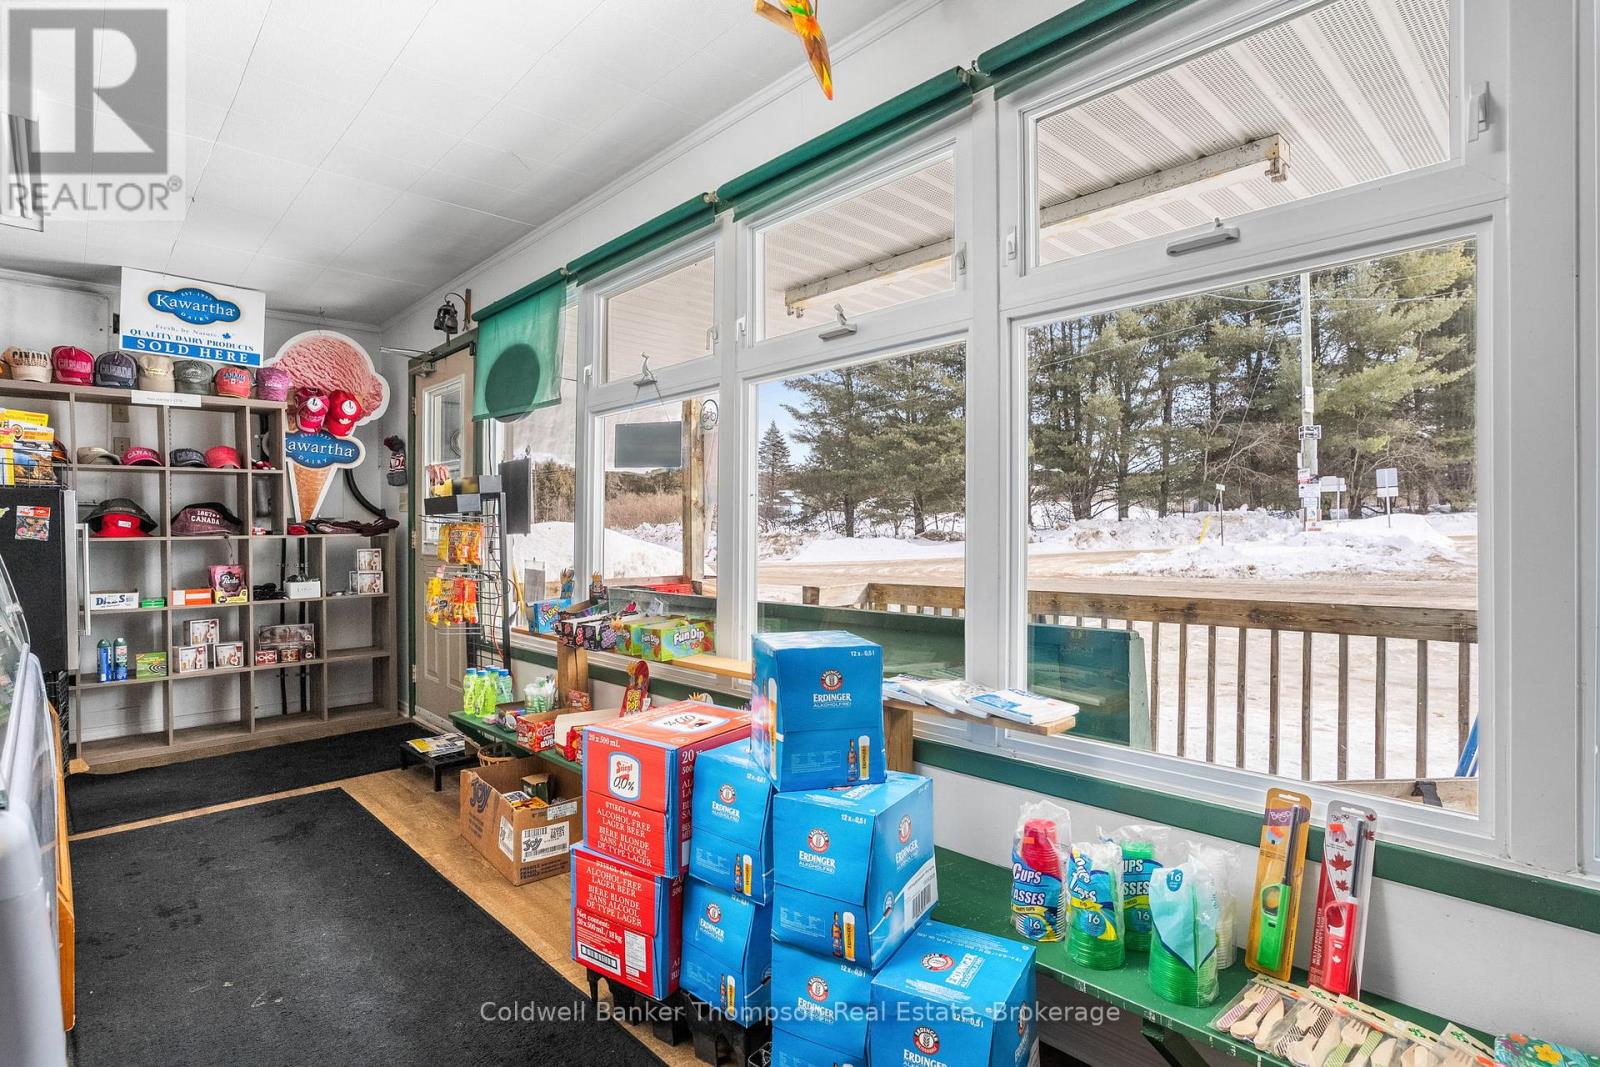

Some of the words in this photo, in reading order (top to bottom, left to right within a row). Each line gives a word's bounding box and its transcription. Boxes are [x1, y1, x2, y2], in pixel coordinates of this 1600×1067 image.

[156, 293, 236, 317] Kawartha
[130, 328, 174, 340] QUALITY
[175, 335, 205, 346] DAIRY
[207, 339, 255, 352] PRODUCTS
[136, 338, 190, 354] SOLD
[200, 347, 249, 363] HERE
[285, 441, 355, 457] awartha
[191, 516, 220, 525] CANADA
[673, 632, 690, 646] Fun
[690, 628, 705, 643] Dip
[813, 693, 852, 703] ERDINGER
[682, 750, 694, 764] 20
[616, 760, 633, 774] Stiegl
[597, 808, 629, 824] ALCOHOL
[631, 819, 651, 832] FREE
[602, 817, 625, 831] LAGER
[626, 825, 645, 838] BEER
[599, 834, 617, 846] SANS
[618, 842, 649, 858] ALCOOL
[620, 834, 650, 850] BLONDE
[597, 841, 606, 850] DE
[609, 845, 626, 858] TYPE
[627, 852, 652, 867] LAGER
[799, 850, 836, 869] ERDINGER
[586, 866, 622, 883] ALCOHOL
[623, 879, 642, 892] FREE
[1013, 863, 1042, 884] CUPS
[1170, 871, 1182, 881] 16
[592, 876, 616, 891] LAGER
[617, 885, 636, 898] BEER
[589, 893, 607, 906] SANS
[608, 901, 639, 918] ALCOOL
[610, 893, 640, 909] BLONDE
[586, 900, 596, 910] DE
[598, 904, 616, 917] TYPE
[616, 912, 642, 928] LAGER
[1029, 918, 1041, 929] 16
[1088, 914, 1100, 925] 16
[1137, 911, 1149, 921] 16
[700, 918, 725, 937] ERDINGER
[903, 1049, 948, 1067] ERDINGER
